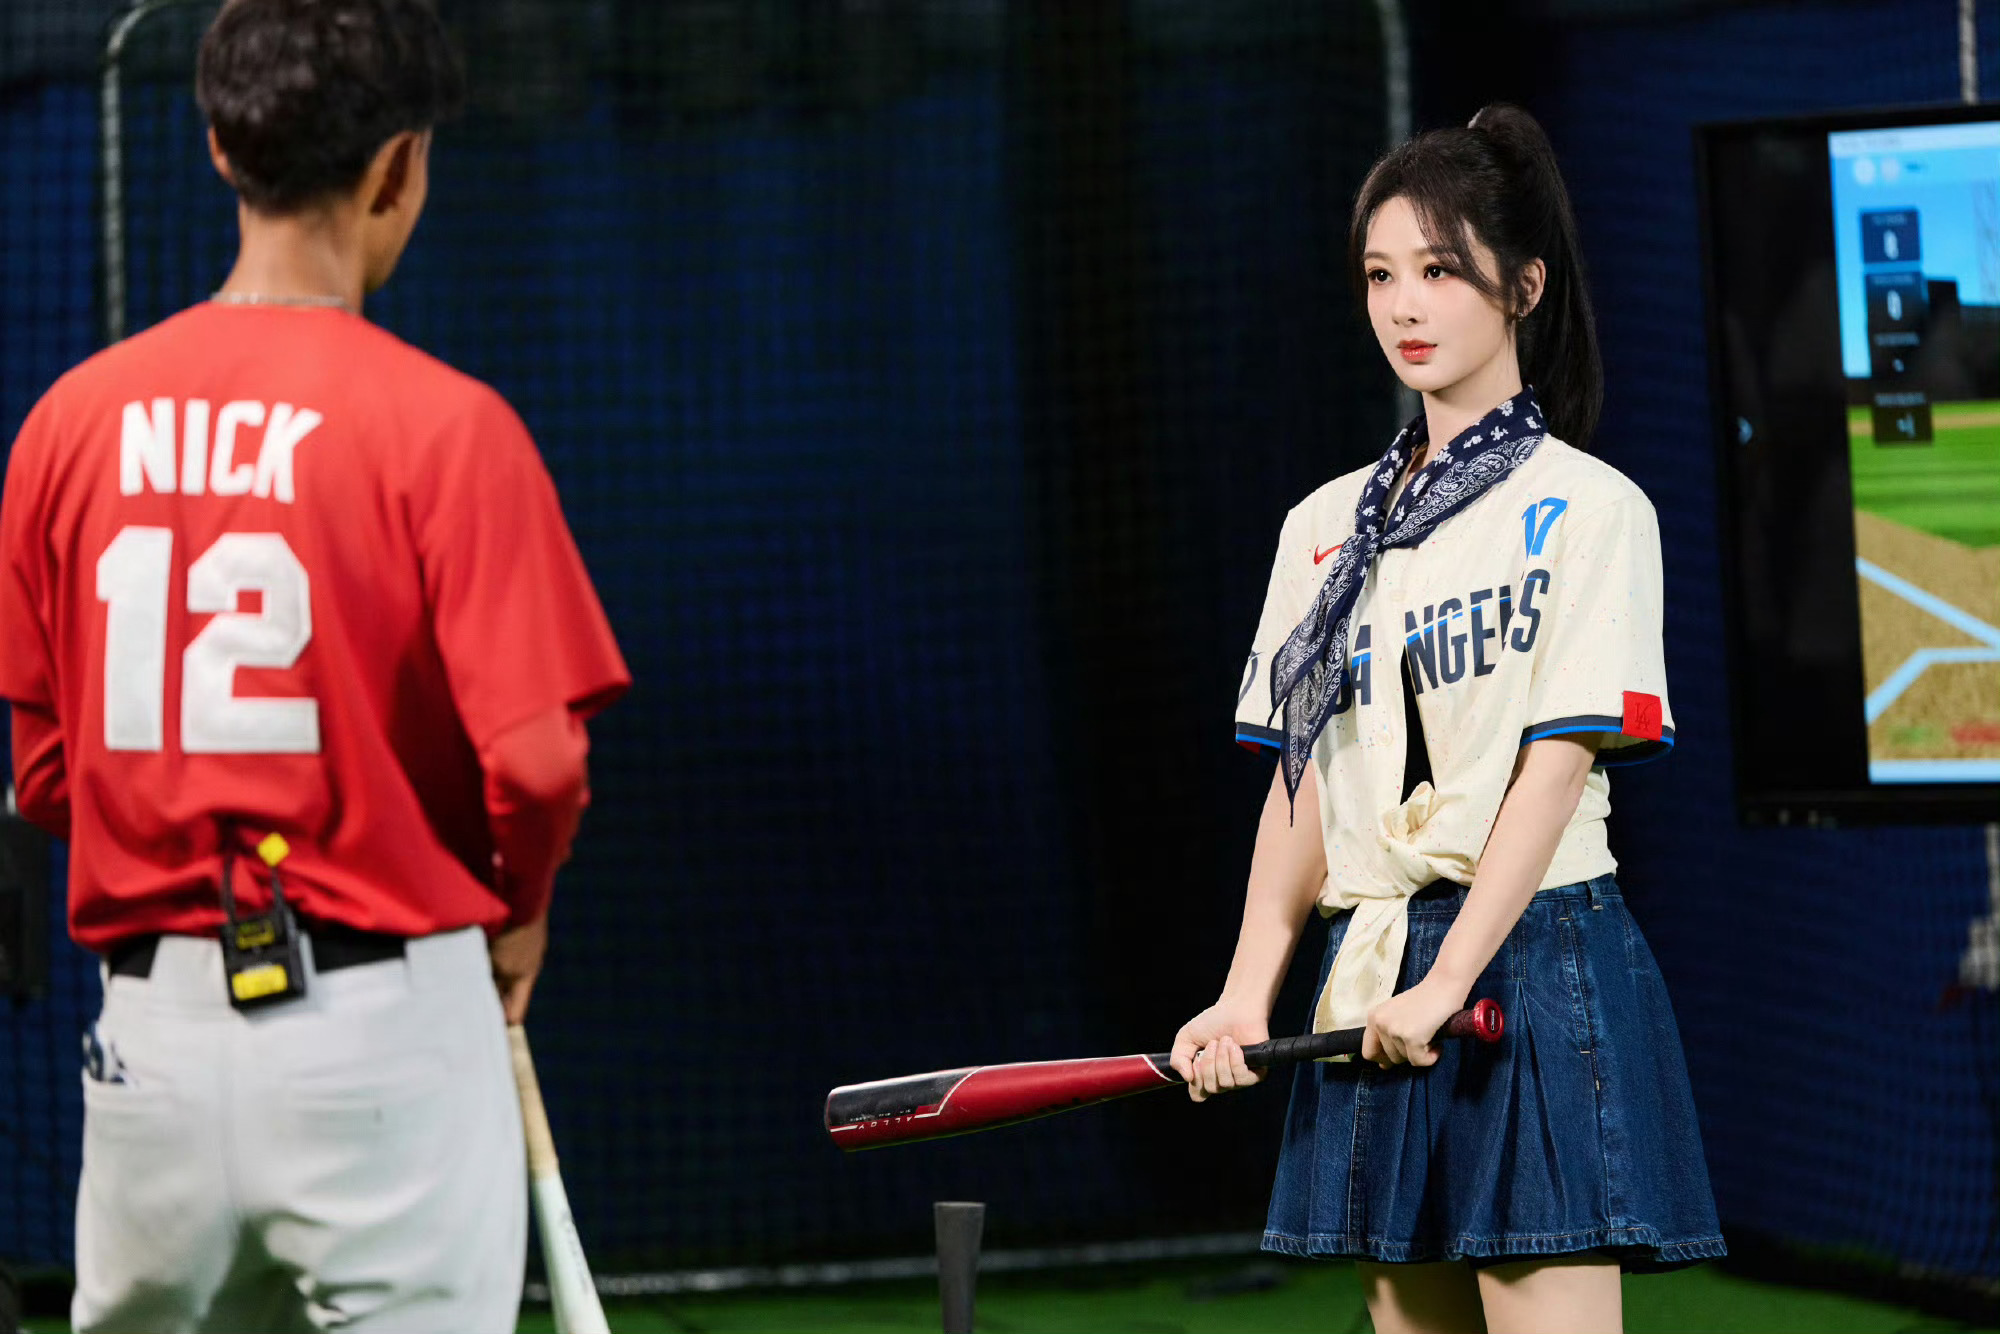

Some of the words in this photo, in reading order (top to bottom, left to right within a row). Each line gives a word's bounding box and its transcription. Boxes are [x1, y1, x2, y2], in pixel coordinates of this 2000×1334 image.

[120, 398, 322, 503] NICK
[1521, 497, 1568, 560] 17
[96, 525, 321, 753] 12
